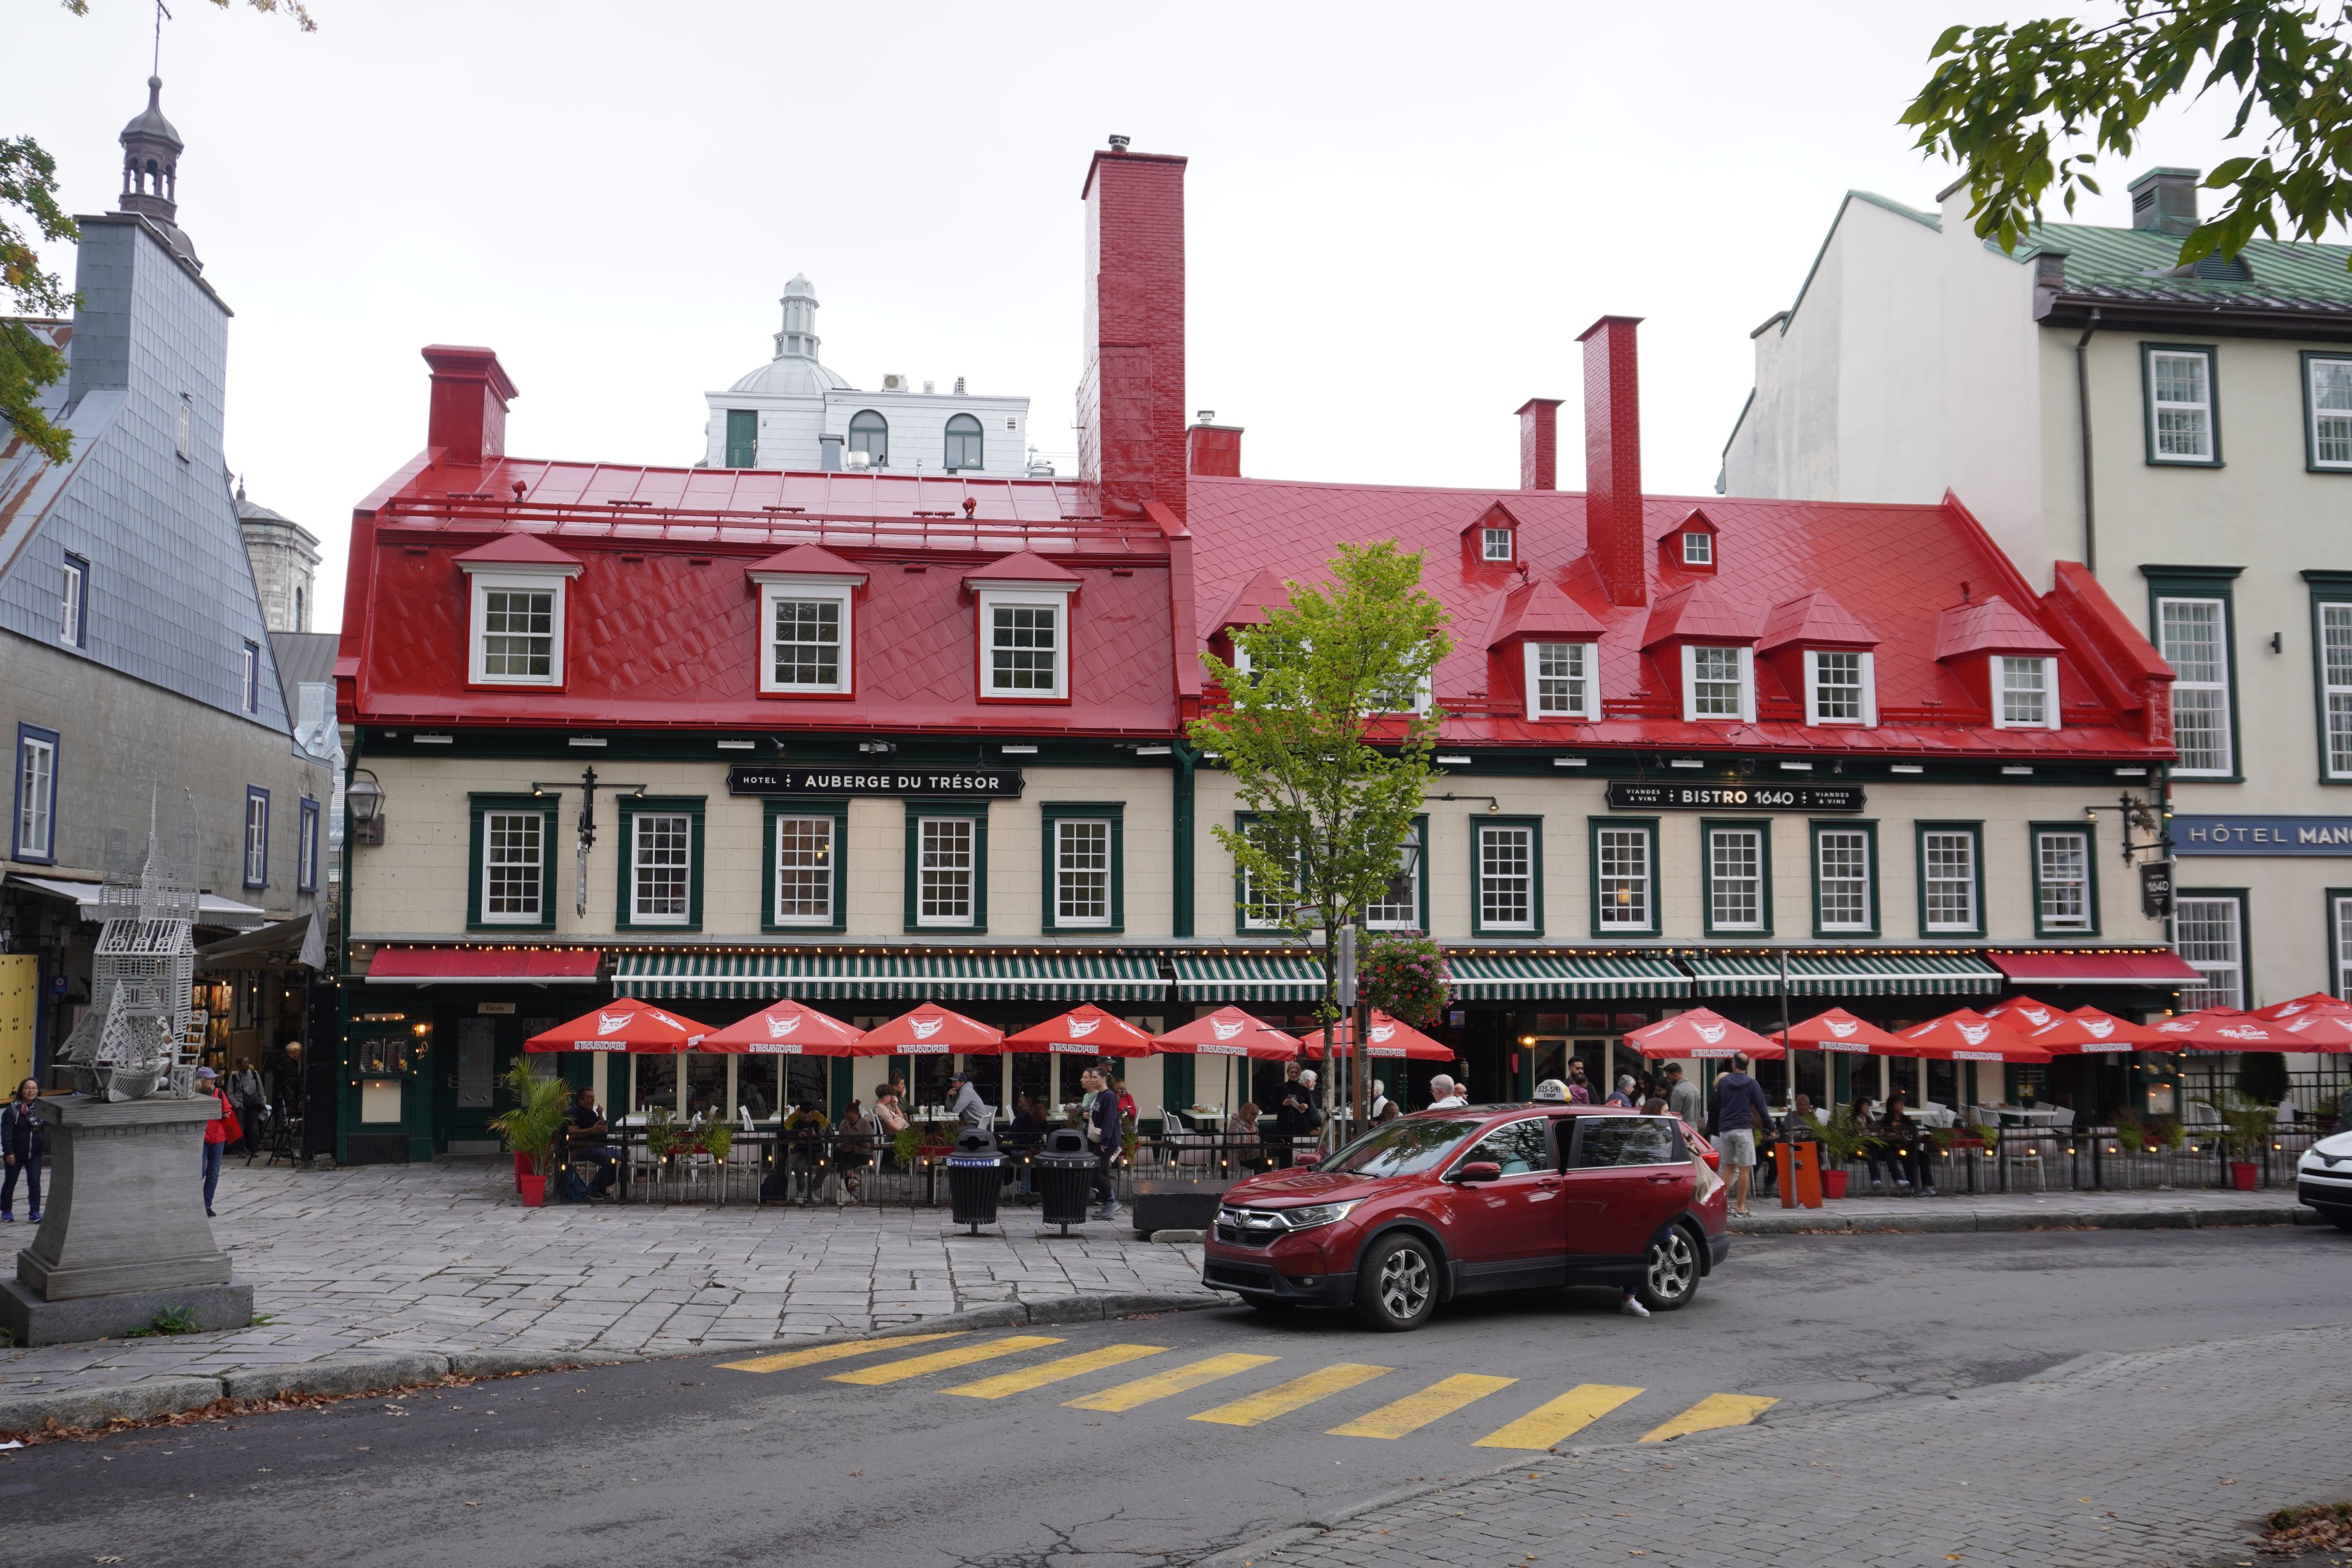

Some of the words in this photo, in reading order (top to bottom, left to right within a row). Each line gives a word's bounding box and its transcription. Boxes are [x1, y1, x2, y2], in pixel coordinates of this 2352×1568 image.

[805, 775, 890, 788] AUBERGE
[898, 776, 921, 788] DU
[929, 774, 999, 789] TRÉSOR
[1683, 790, 1748, 804] BISTRO
[1754, 791, 1794, 805] 1640
[2188, 823, 2288, 842] HÔTEL
[2297, 827, 2352, 844] MAN
[2148, 881, 2169, 892] 1640
[417, 1041, 429, 1060] 20
